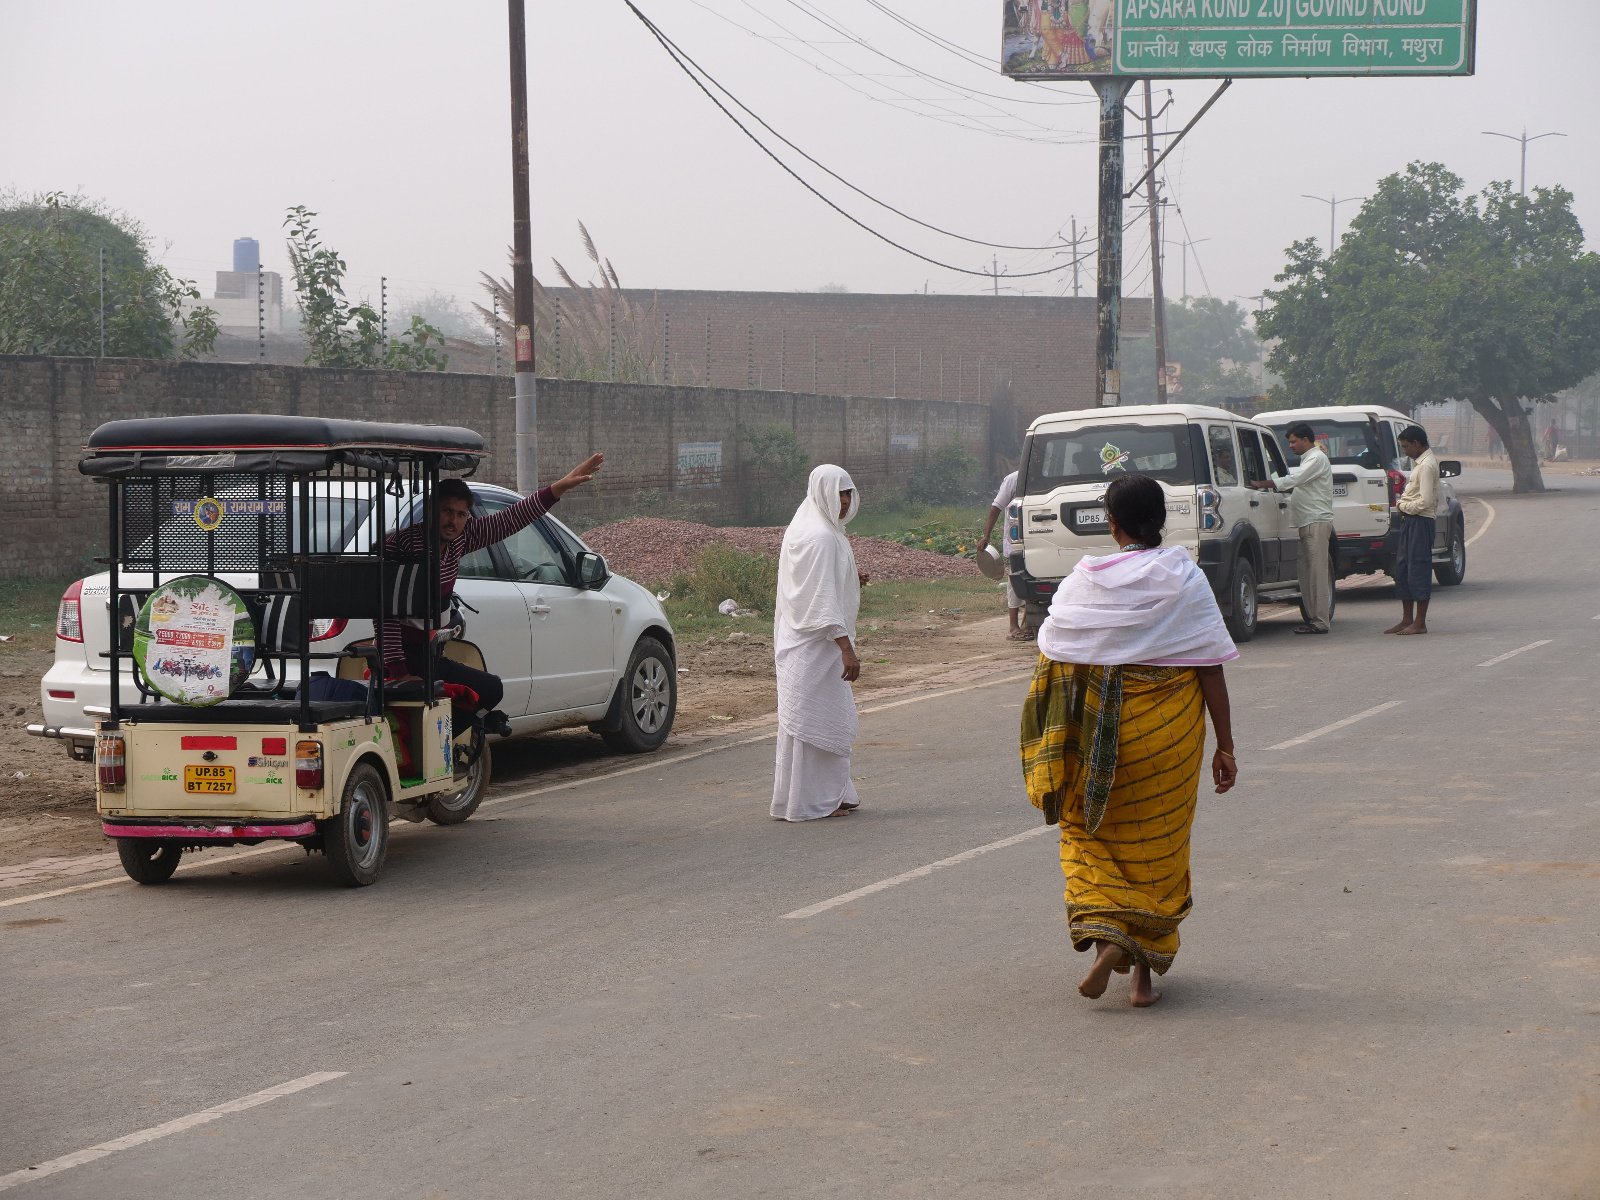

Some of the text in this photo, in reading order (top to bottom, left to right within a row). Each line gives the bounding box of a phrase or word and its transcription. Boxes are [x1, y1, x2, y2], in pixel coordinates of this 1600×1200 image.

[1125, 0, 1197, 19] APSARA
[1201, 0, 1249, 18] KUND
[1295, 0, 1426, 17] GOVIND KUND
[1127, 34, 1179, 58] प्रान्तीय
[1236, 34, 1273, 57] लोक
[1281, 33, 1332, 57] निर्माण
[1342, 33, 1393, 58] विभाग,
[1401, 38, 1444, 62] मथुरा
[175, 501, 191, 513] राम
[230, 501, 247, 513] राम
[247, 501, 264, 513] राम
[267, 501, 284, 513] राम
[1078, 514, 1100, 523] UP85
[187, 781, 233, 791] BT 7257
